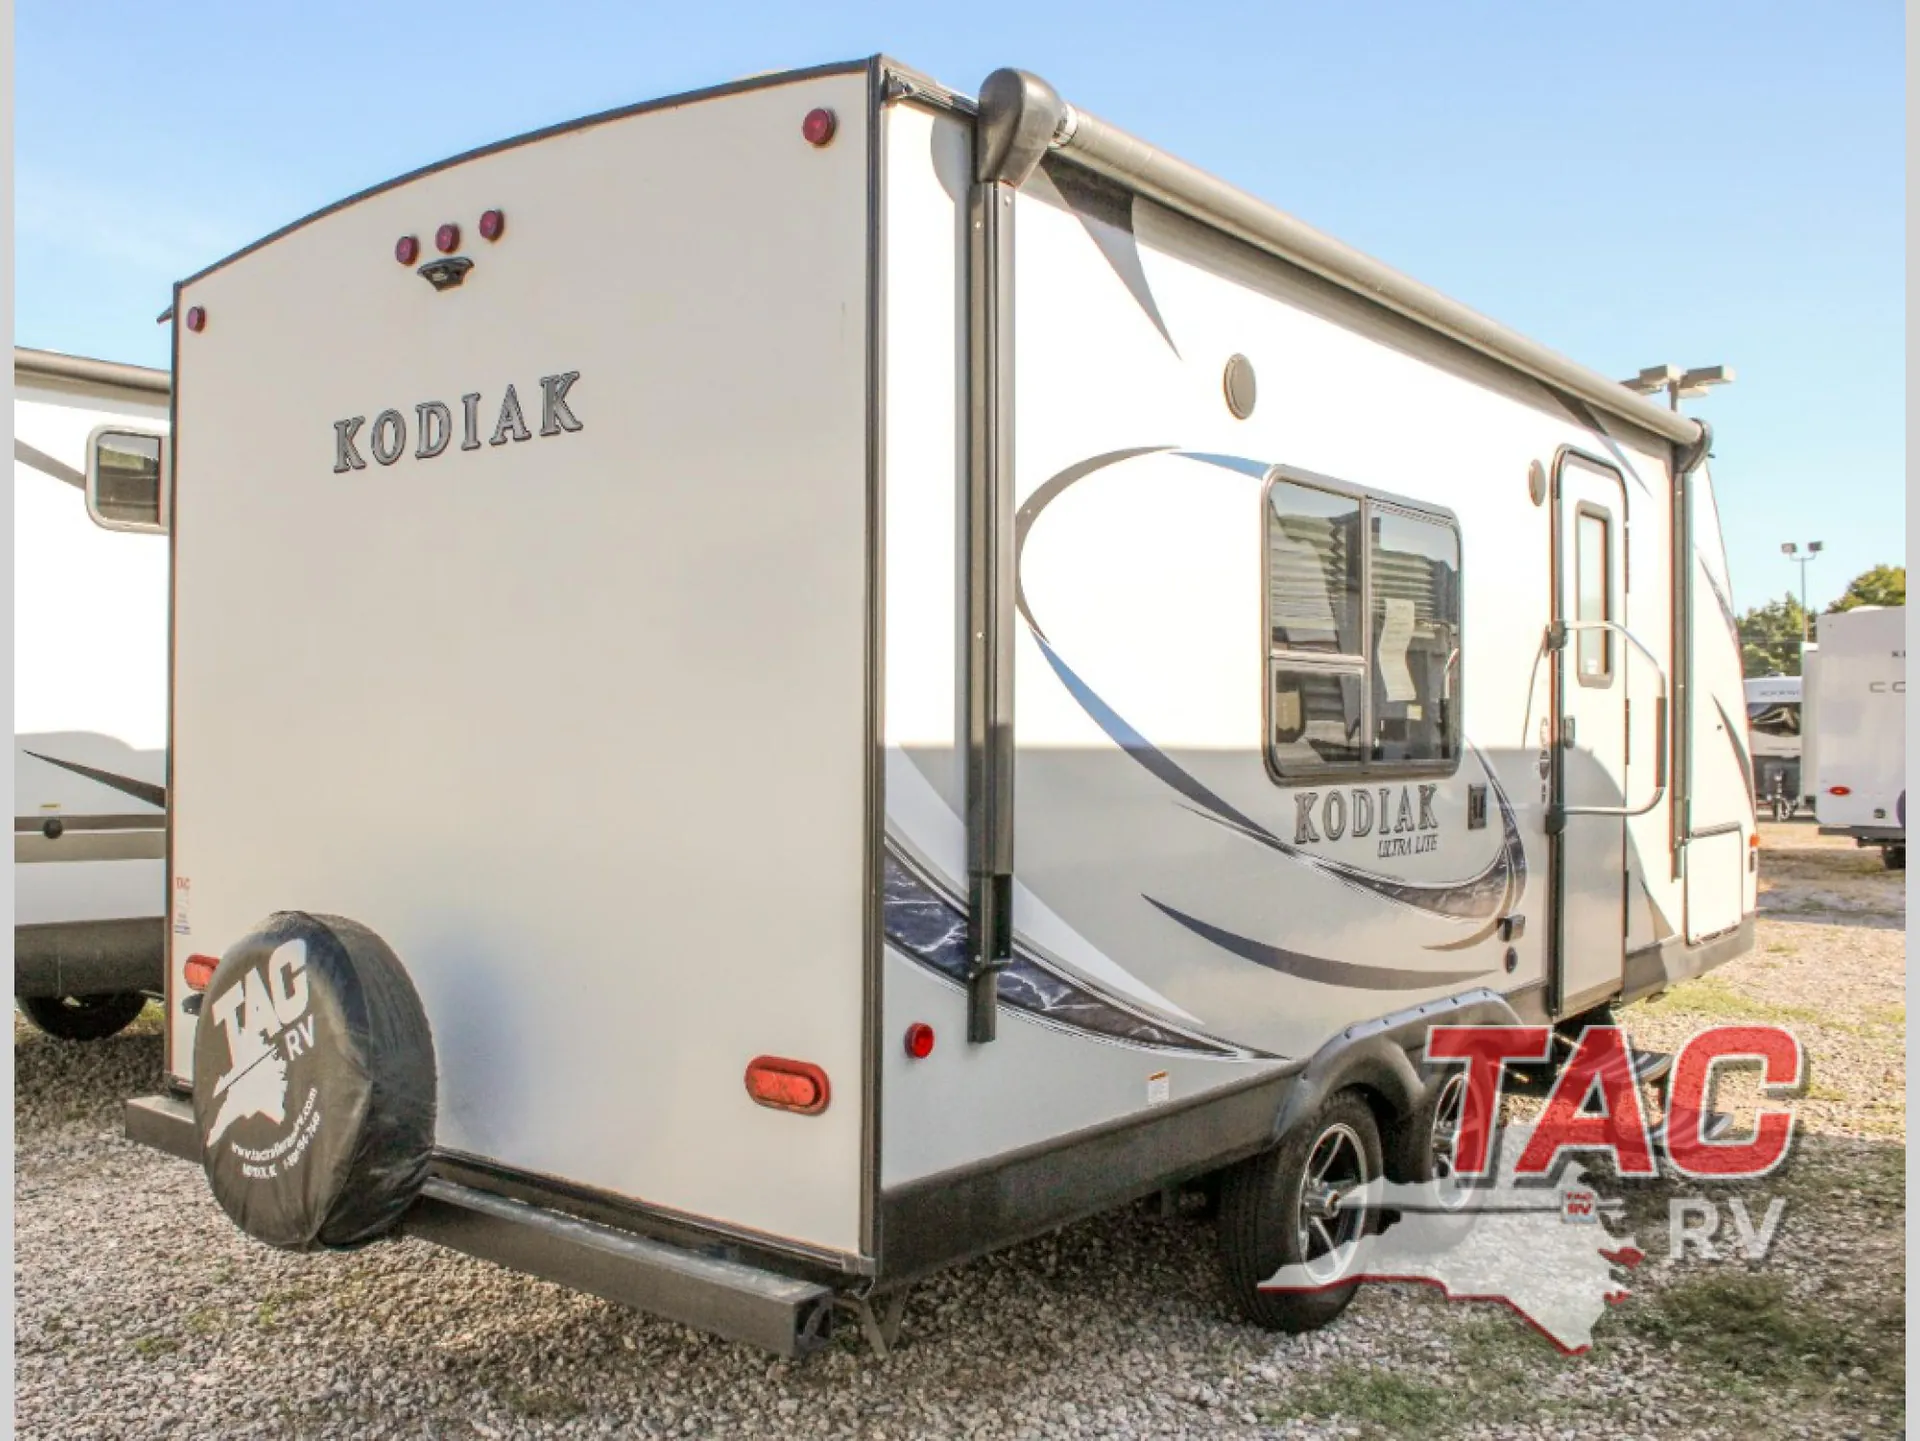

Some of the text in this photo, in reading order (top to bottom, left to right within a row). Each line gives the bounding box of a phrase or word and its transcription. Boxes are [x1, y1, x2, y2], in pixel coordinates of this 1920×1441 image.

[332, 370, 585, 474] KODIAK
[1294, 783, 1439, 845] KODIAK
[1377, 833, 1439, 859] ULTRA LITE
[212, 938, 308, 1066] TAC
[285, 1013, 315, 1061] RV
